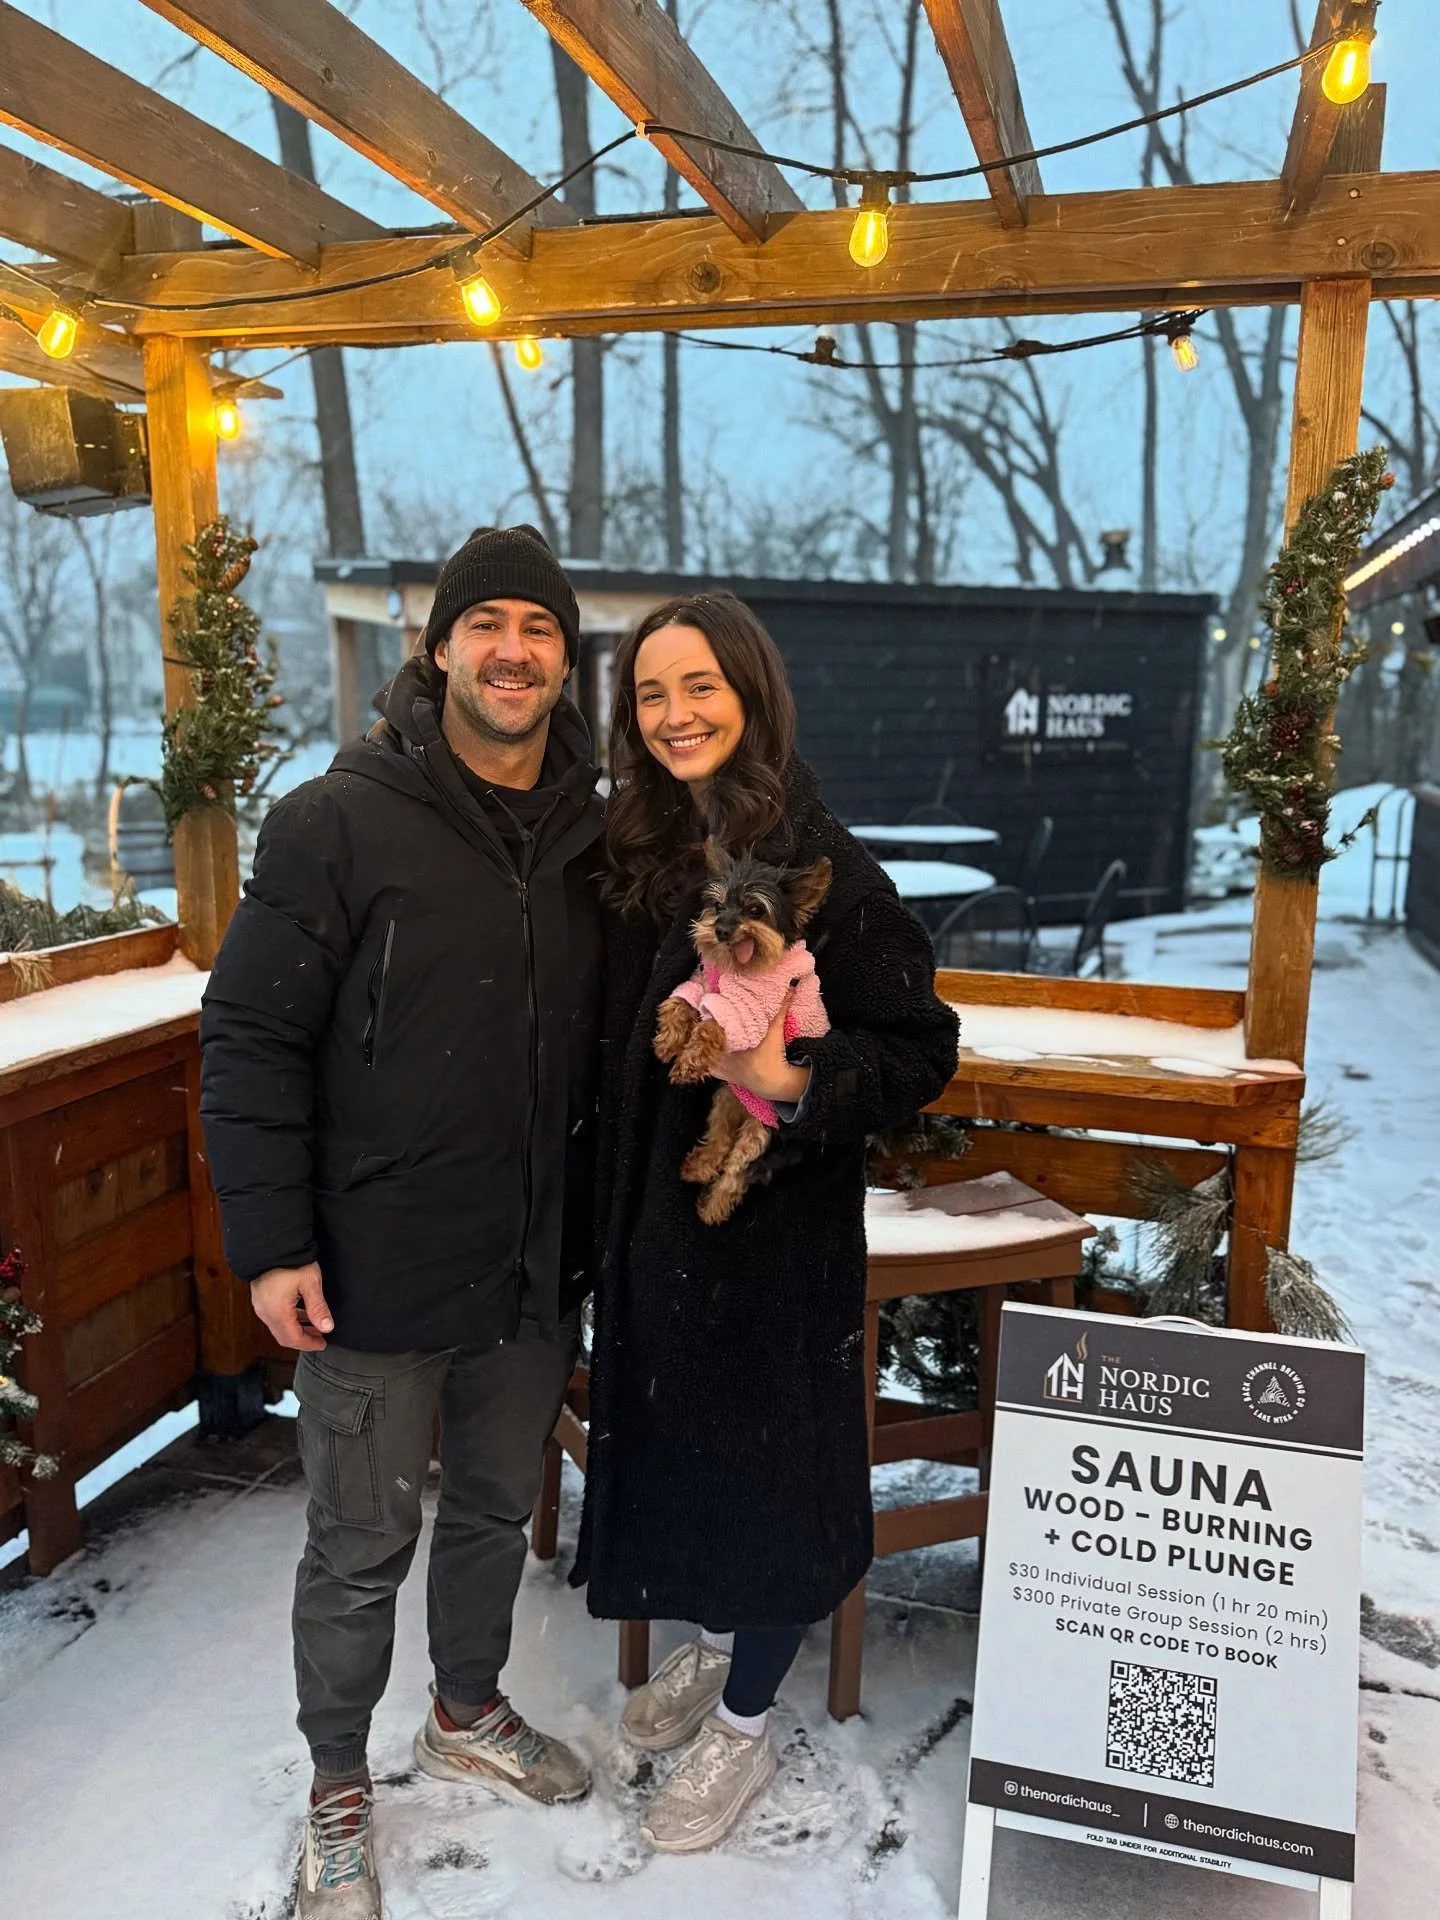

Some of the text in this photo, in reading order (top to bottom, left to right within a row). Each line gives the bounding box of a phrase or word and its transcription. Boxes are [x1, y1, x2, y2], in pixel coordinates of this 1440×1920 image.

[1047, 693, 1132, 717] NORDIC
[1046, 716, 1104, 738] HAUS
[1101, 1355, 1121, 1364] THE
[1246, 1361, 1278, 1380] CHANNEL
[1100, 1366, 1211, 1398] NORDIC
[1242, 1381, 1253, 1402] BACK
[1280, 1364, 1306, 1394] BREWING
[1099, 1388, 1173, 1416] HAUS
[1253, 1409, 1272, 1423] LAKE
[1070, 1444, 1273, 1511] SAUNA
[1024, 1486, 1125, 1522] WOOD
[1162, 1508, 1313, 1551] BURNING
[1044, 1528, 1294, 1586] + COLD PLUNGE
[1008, 1562, 1329, 1631] $30 Individual Session (1 hr 20 min)
[1013, 1586, 1328, 1655] $300 Private Group Session (2 hrs)
[1055, 1618, 1278, 1669] SCAN QR CODE TO BOOK
[1020, 1785, 1314, 1857] thenordichaus_ thenordichaus.com
[1086, 1833, 1232, 1869] FOLD TAB UNDER FOR ADDITIONAL STABILITY
